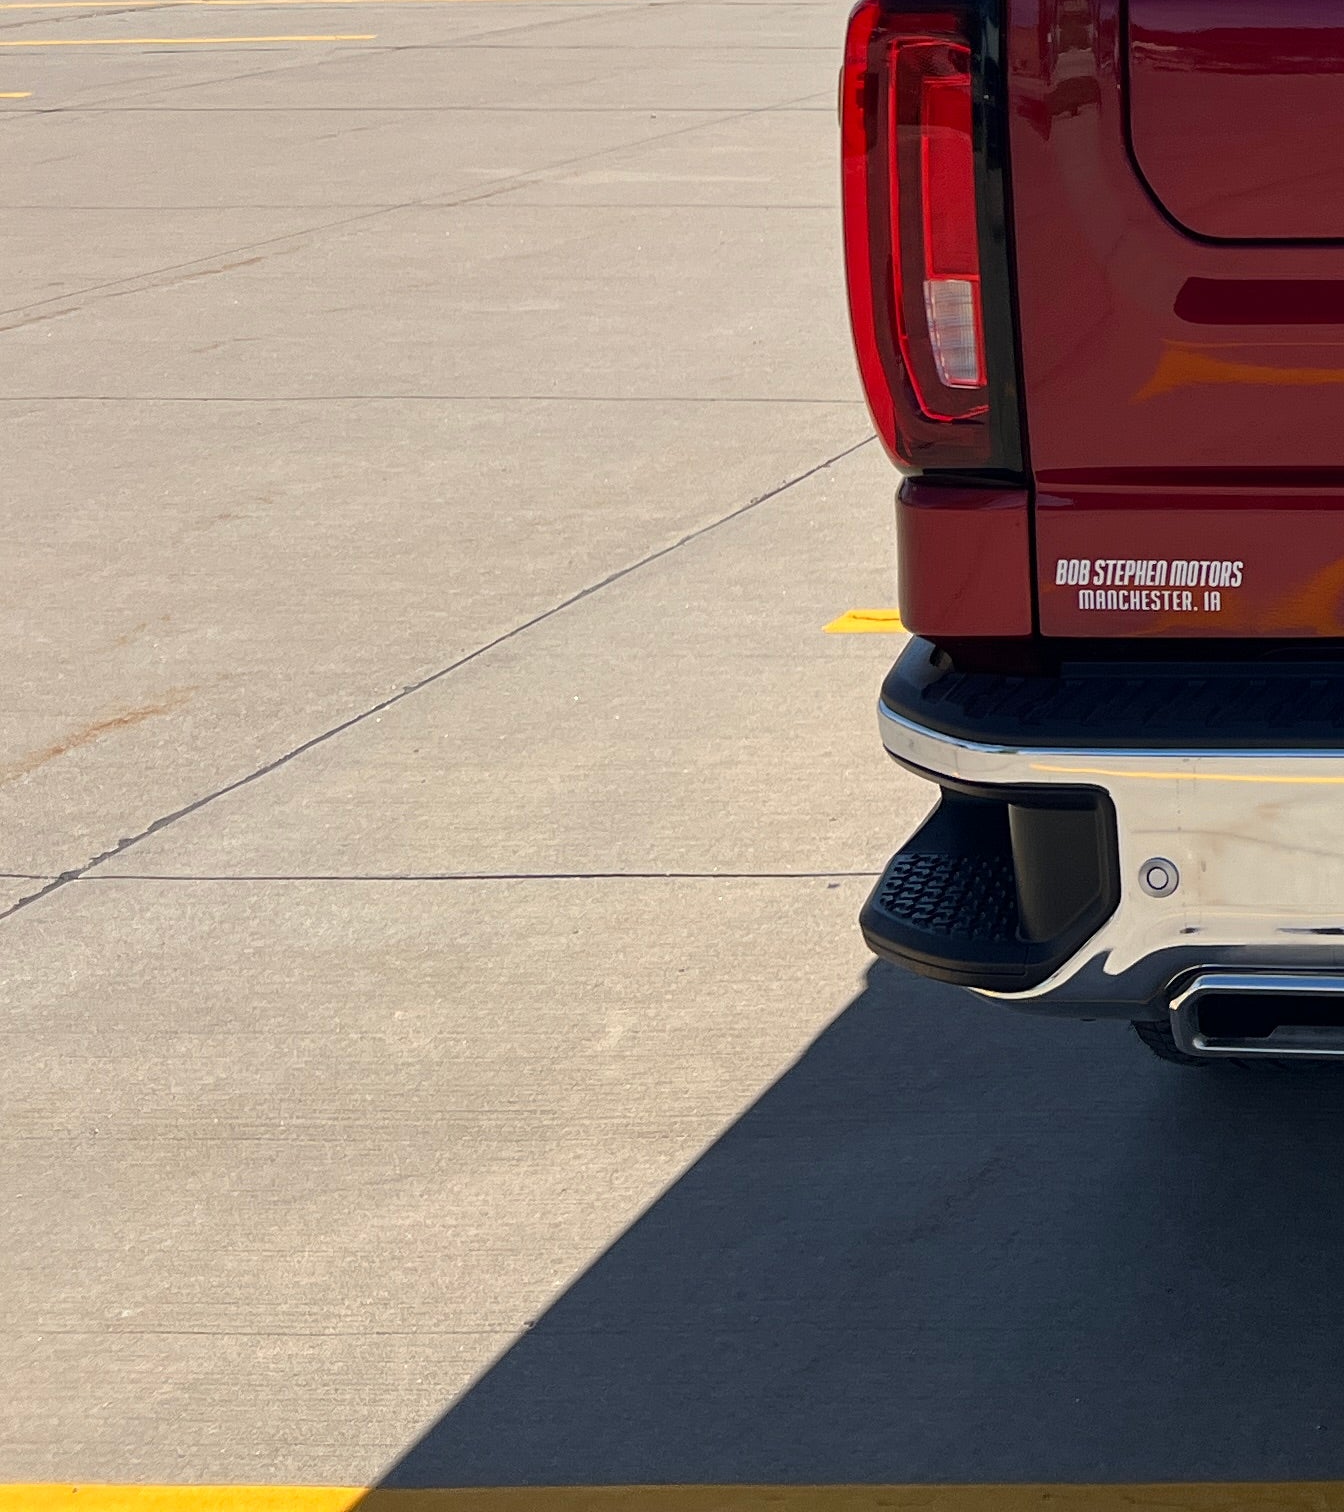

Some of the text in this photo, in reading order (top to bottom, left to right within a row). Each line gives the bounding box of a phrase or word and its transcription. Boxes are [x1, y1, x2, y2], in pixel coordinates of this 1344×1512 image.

[1055, 559, 1244, 587] BOB STEPHEN MOTORS
[1203, 591, 1221, 611] IA
